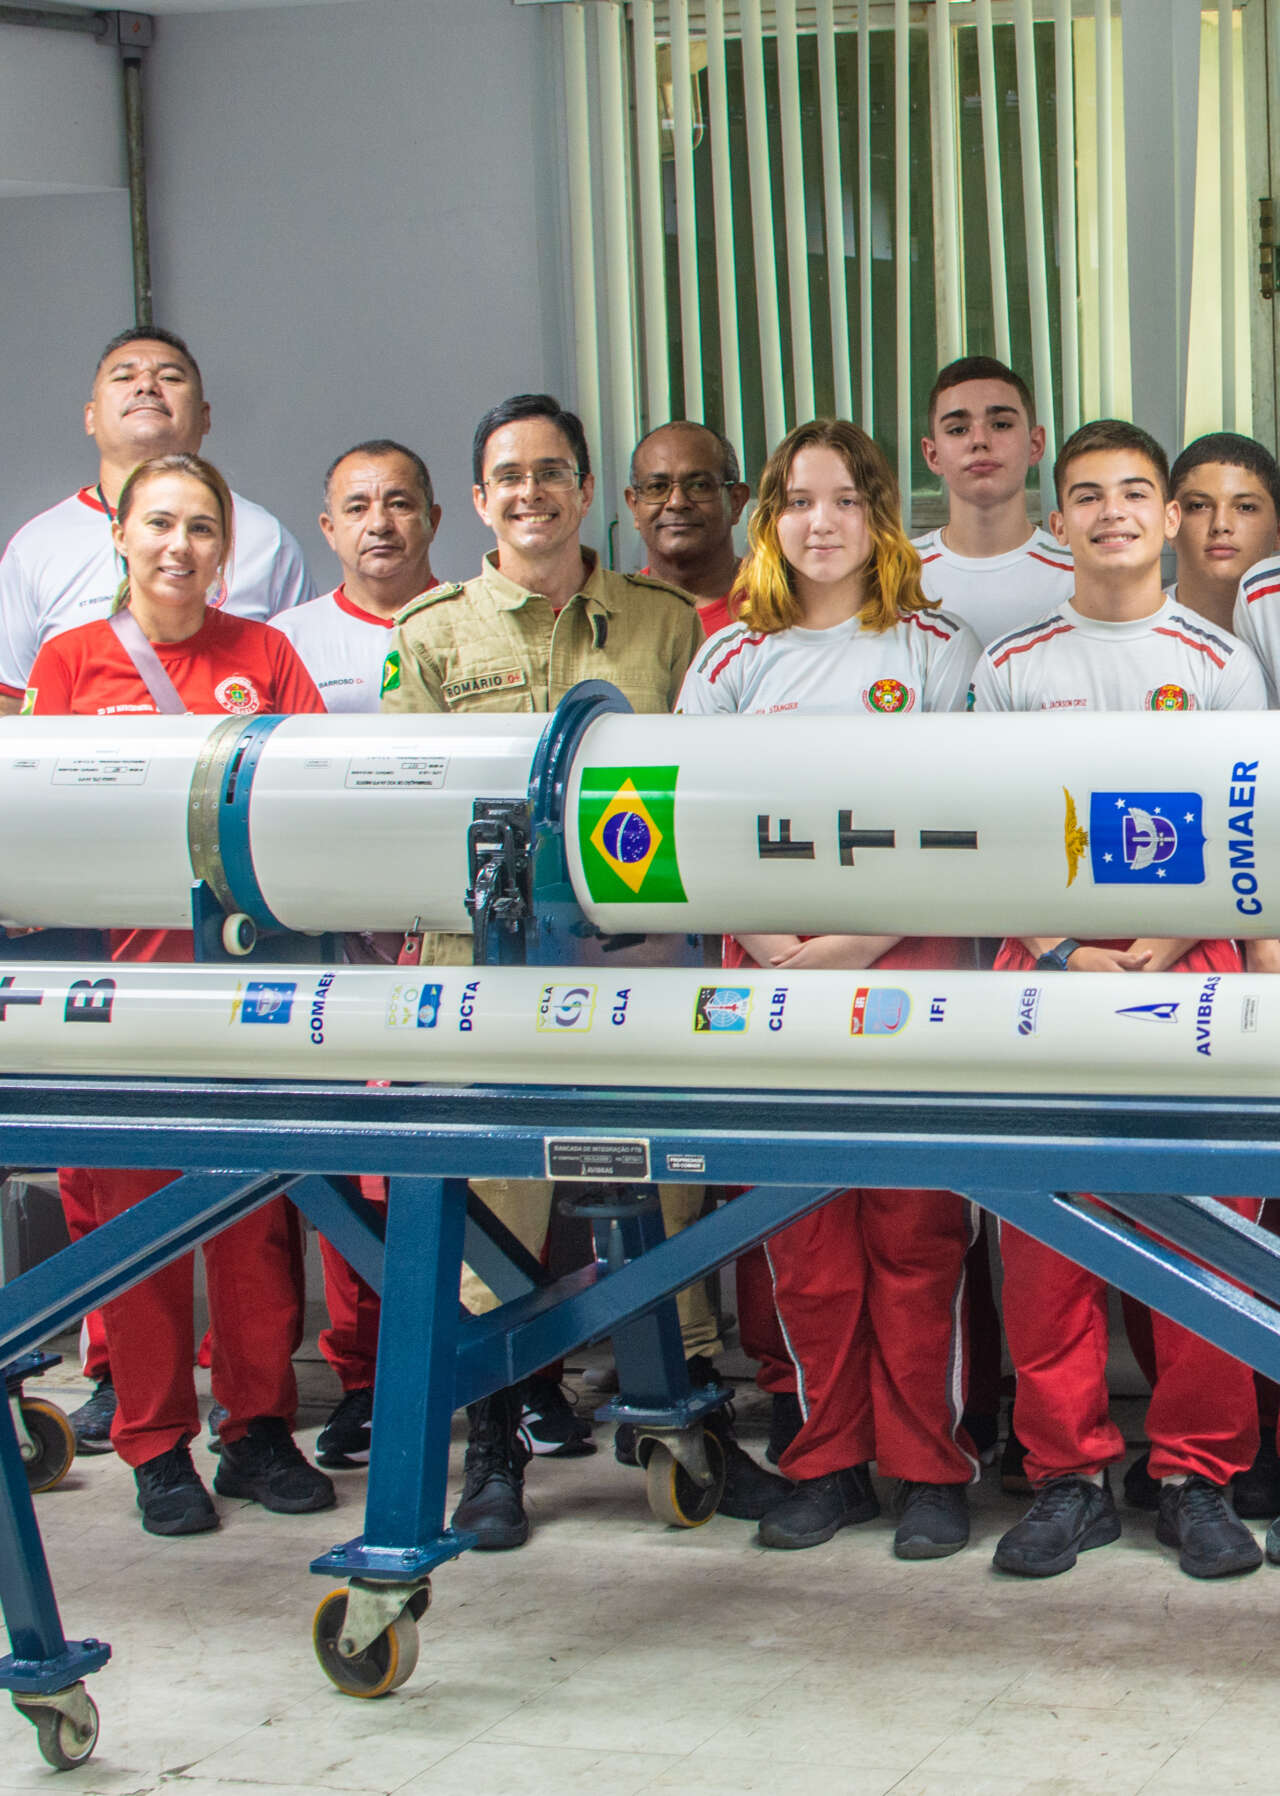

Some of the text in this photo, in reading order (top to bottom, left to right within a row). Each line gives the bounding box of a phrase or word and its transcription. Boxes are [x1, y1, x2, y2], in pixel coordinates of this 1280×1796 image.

[318, 678, 354, 689] BARROSO
[1228, 760, 1263, 916] COMAER
[459, 981, 480, 1032] DCTA
[541, 986, 554, 1014] CLA
[611, 988, 631, 1026] CLA
[768, 987, 789, 1032] CLBI
[929, 997, 947, 1022] IFI
[1019, 988, 1038, 1021] AEB
[1196, 976, 1221, 1056] AVIBRAS
